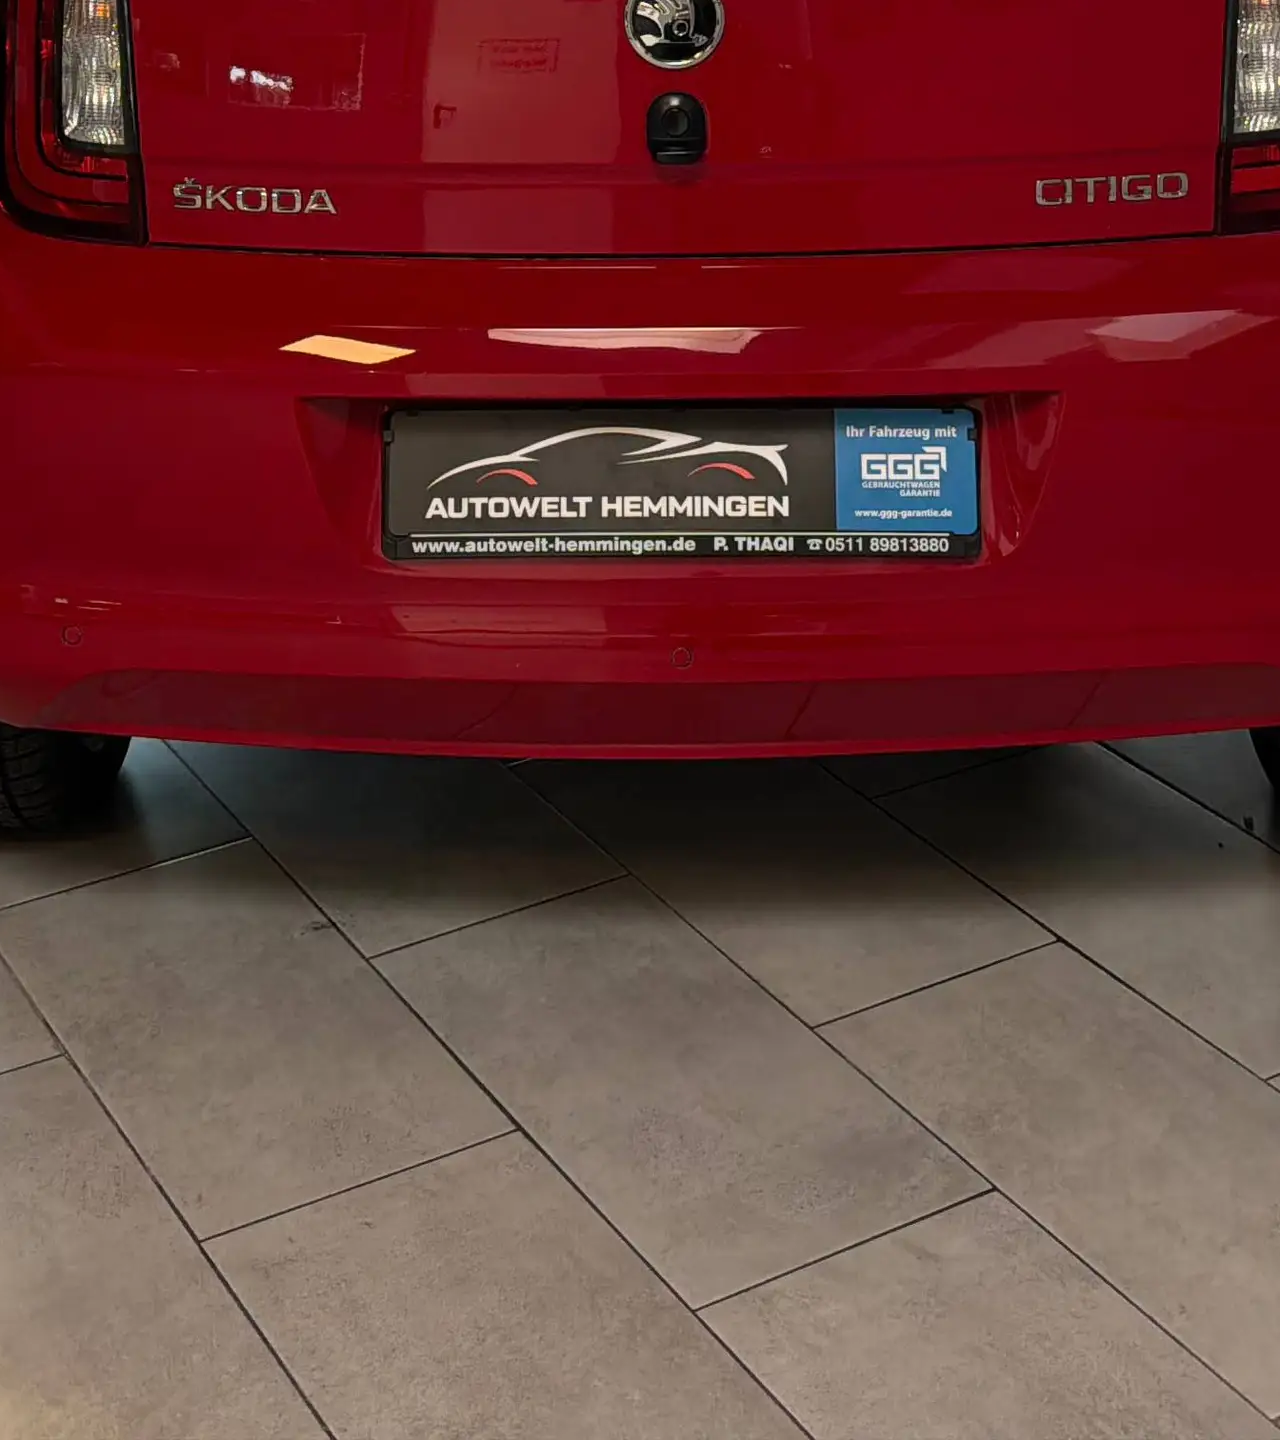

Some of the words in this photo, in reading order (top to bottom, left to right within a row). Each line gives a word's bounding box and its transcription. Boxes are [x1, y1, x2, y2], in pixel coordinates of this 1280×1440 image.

[173, 176, 337, 215] ŠKODA
[1035, 172, 1189, 206] CITIGO
[846, 426, 865, 438] Ihr
[869, 425, 930, 440] Fahrzeug
[934, 426, 957, 438] mit
[861, 453, 941, 480] GGG
[861, 480, 941, 489] GEBRAUCHTWAGEN
[899, 489, 941, 498] GARANTIE
[425, 495, 593, 519] AUTOWELT
[601, 495, 790, 518] HEMMINGEN
[854, 508, 953, 520] www.ggg-garantie.de
[412, 537, 696, 555] www.autowelt-hemmingen.de
[713, 537, 729, 552] P.
[734, 537, 795, 552] THAQI
[825, 537, 863, 553] 0511
[870, 537, 950, 553] 89813880
